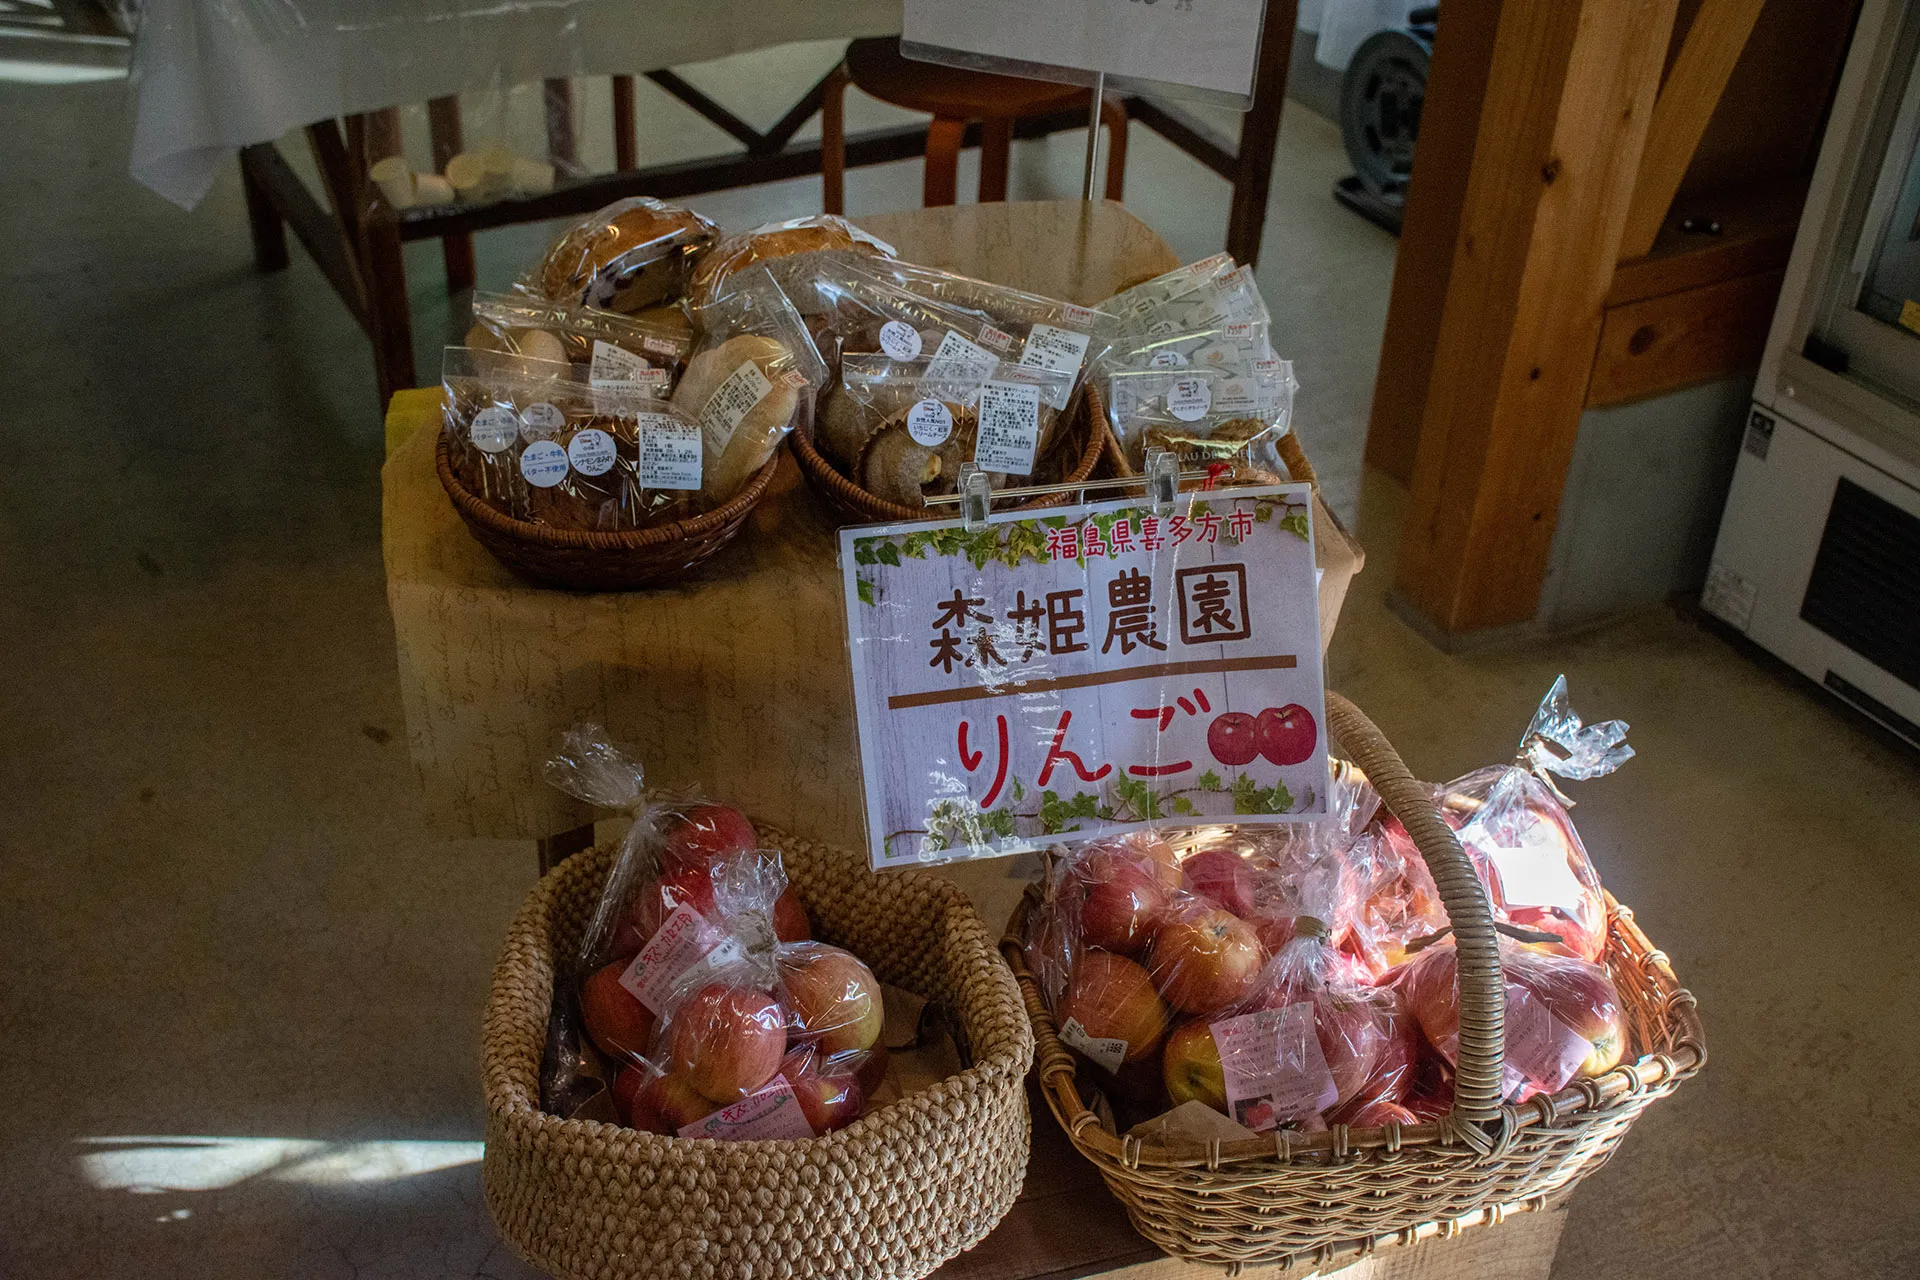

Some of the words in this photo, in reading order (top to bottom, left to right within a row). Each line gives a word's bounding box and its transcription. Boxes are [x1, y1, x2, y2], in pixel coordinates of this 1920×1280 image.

[1045, 507, 1256, 562] 福島県喜多方市
[929, 562, 1252, 675] 森姫農園
[958, 688, 1212, 809] りんご
